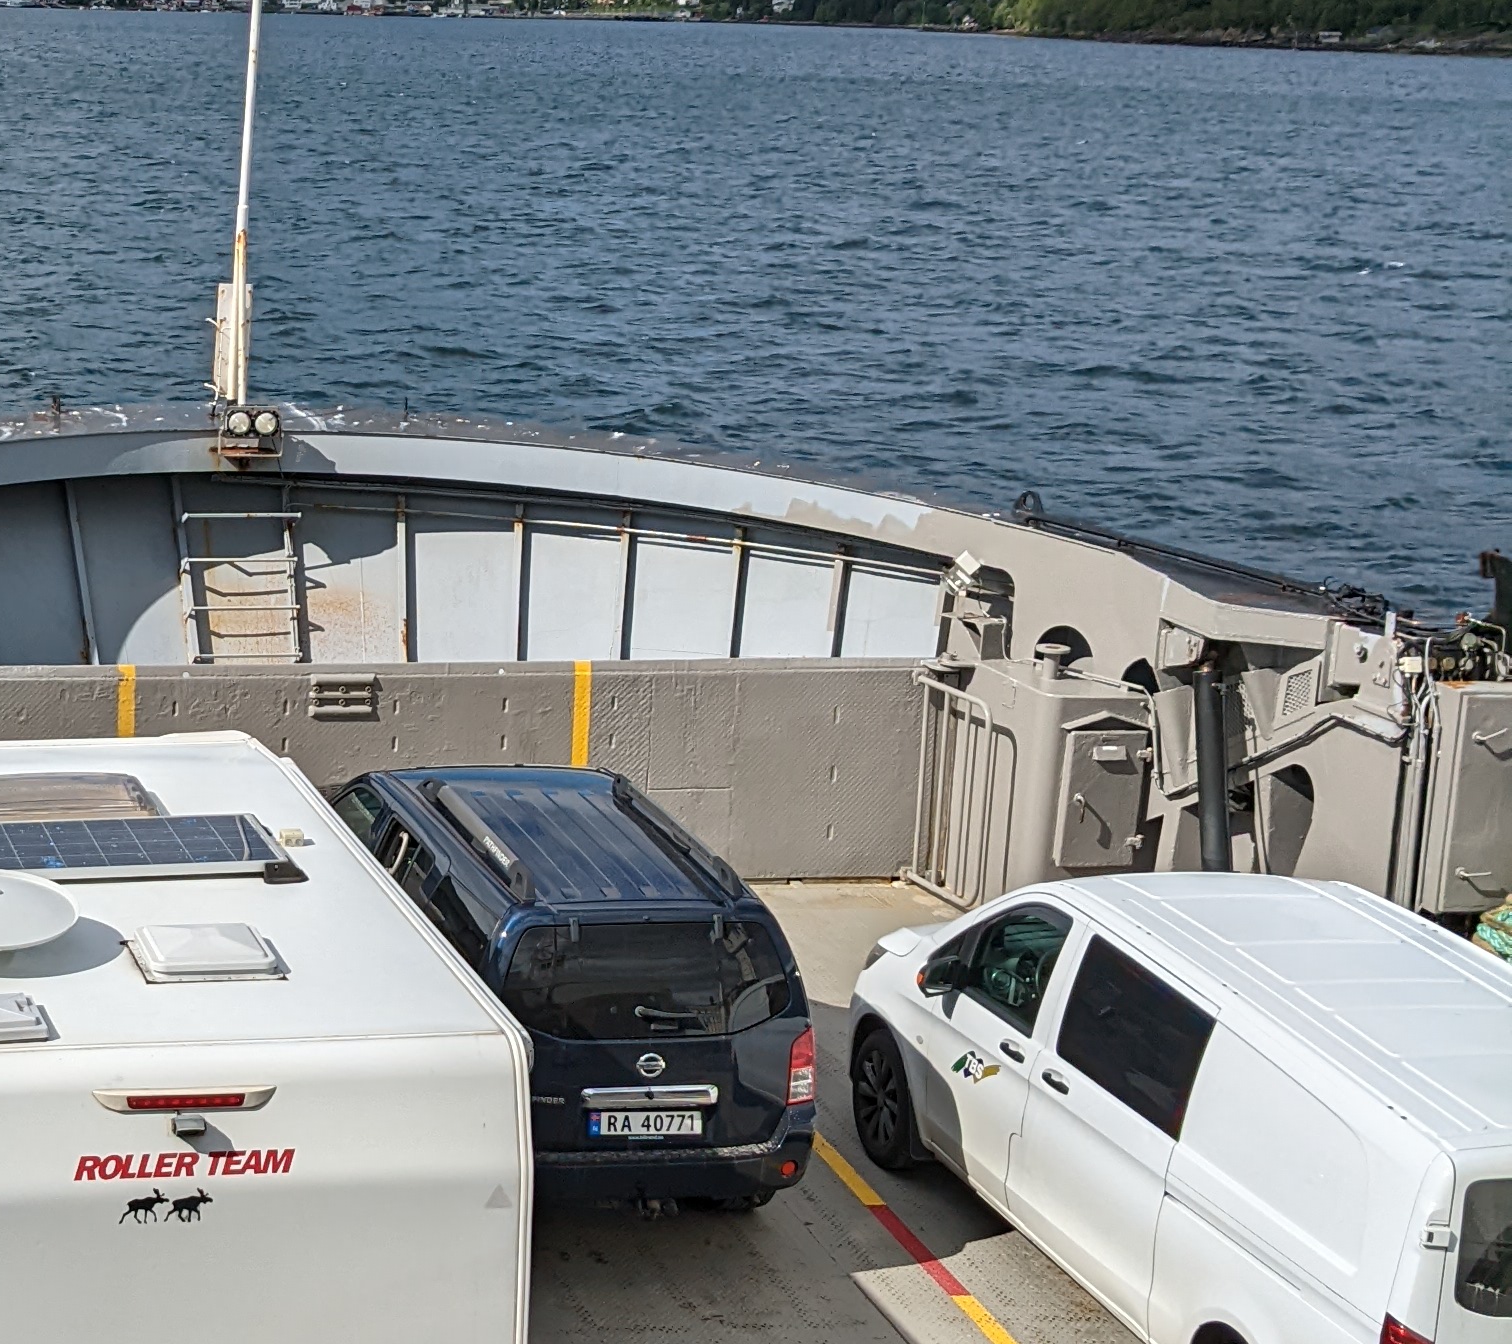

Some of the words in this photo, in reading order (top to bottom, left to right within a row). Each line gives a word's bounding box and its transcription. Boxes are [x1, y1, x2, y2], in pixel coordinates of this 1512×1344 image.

[483, 835, 510, 867] PATHFINDER
[964, 1053, 984, 1080] TBS
[607, 1115, 632, 1133] RA
[641, 1113, 695, 1132] 40771
[74, 1152, 199, 1181] ROLLER
[208, 1148, 295, 1176] TEAM
